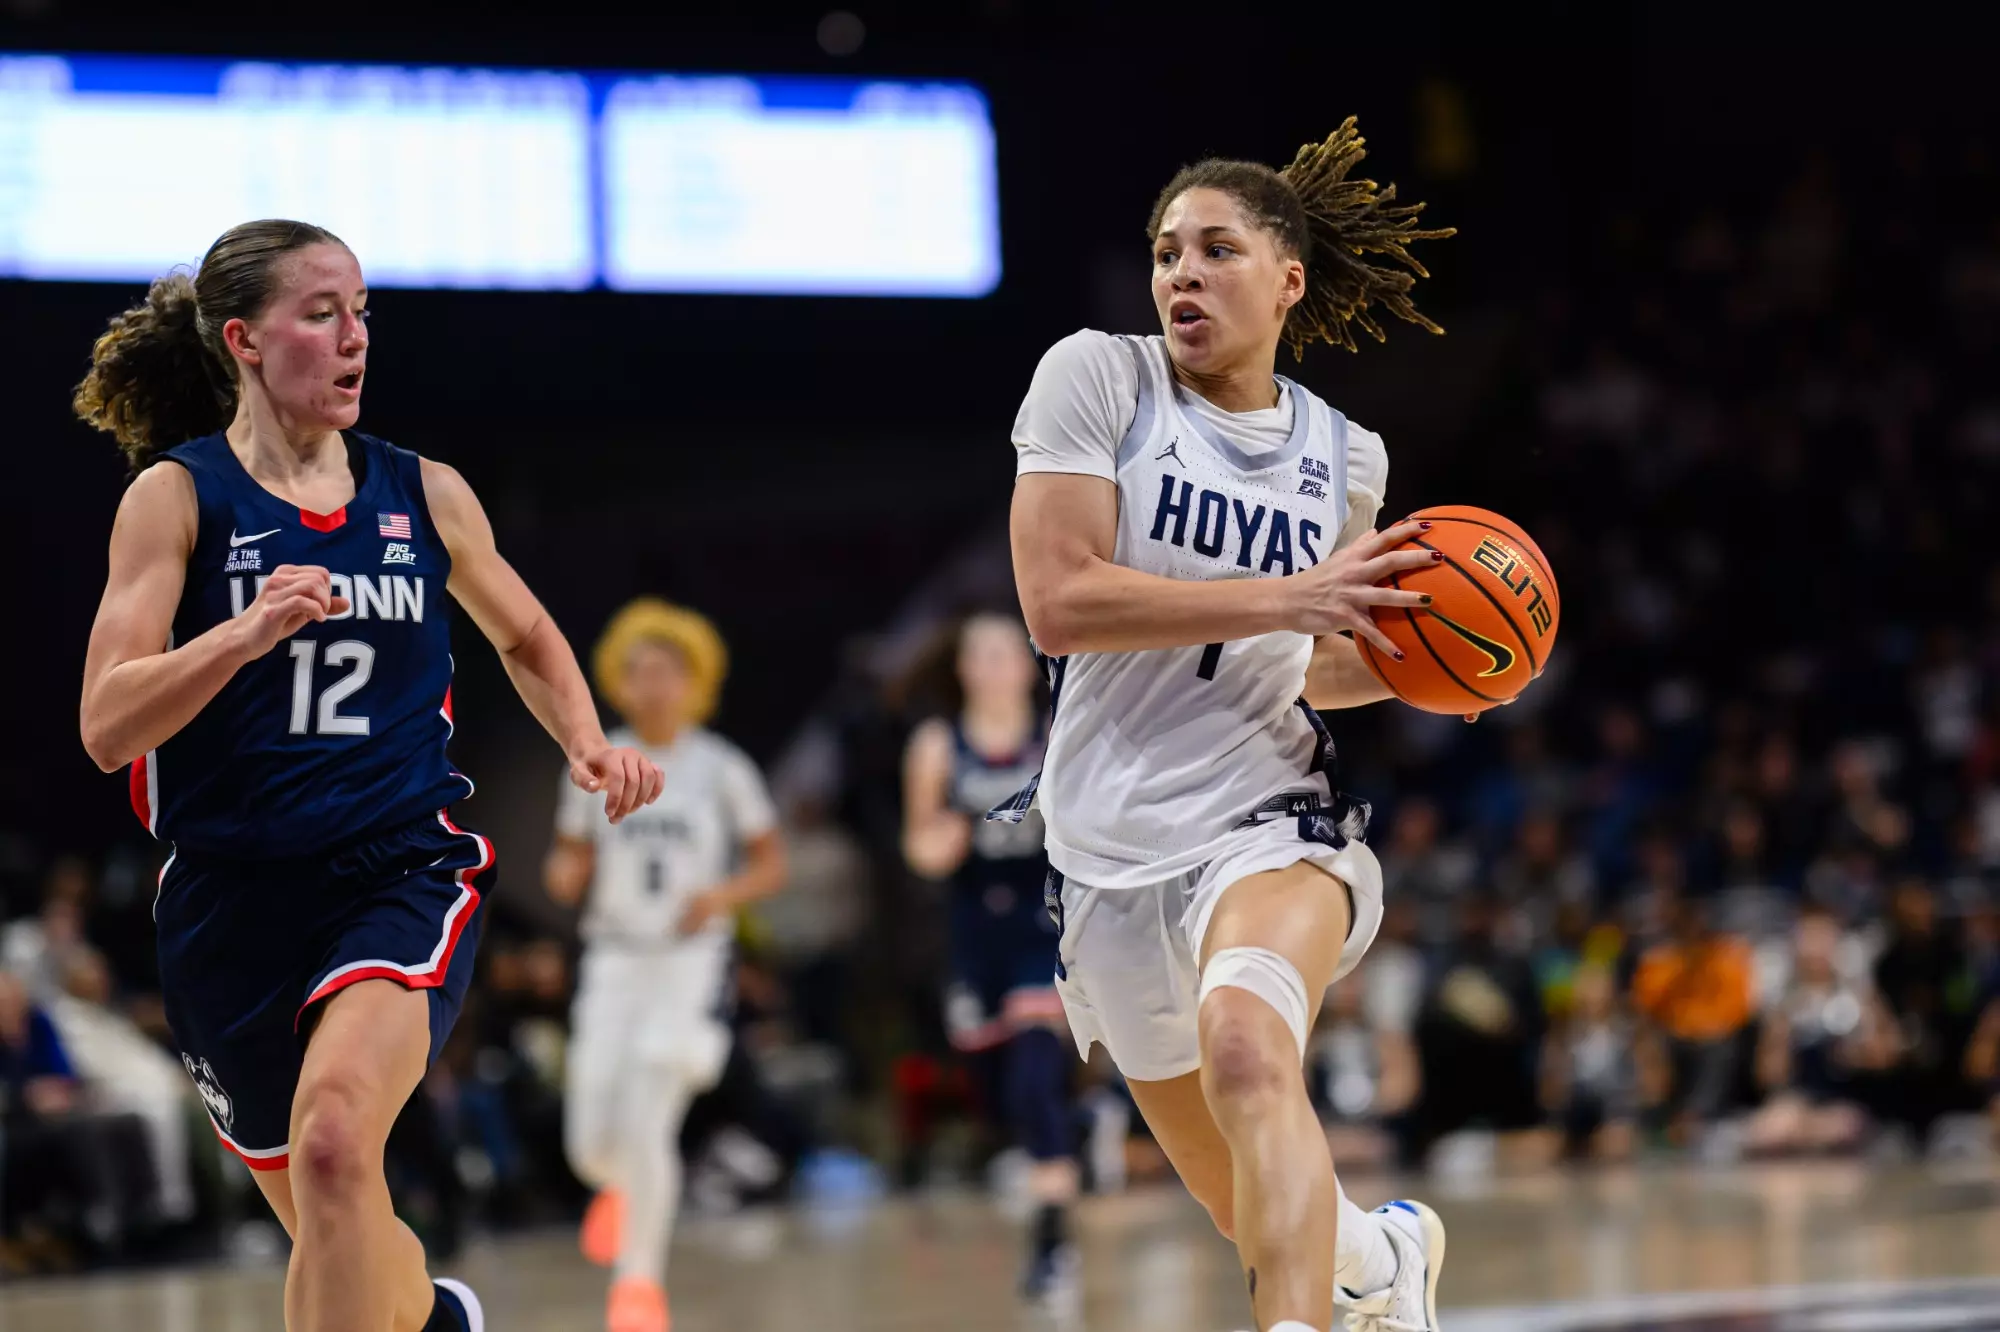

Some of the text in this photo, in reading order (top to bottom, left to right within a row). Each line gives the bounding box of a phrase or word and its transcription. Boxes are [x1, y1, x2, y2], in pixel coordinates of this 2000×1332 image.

[1302, 456, 1329, 474] BE THE
[1299, 465, 1330, 483] CHANGE
[1302, 478, 1322, 491] BIG
[1298, 485, 1328, 499] EAST
[1149, 473, 1322, 577] HOYAS
[240, 550, 260, 560] THE
[386, 543, 410, 554] BIG
[383, 551, 416, 562] EAST
[224, 559, 262, 572] CHANGE
[1470, 538, 1552, 638] ELITE
[229, 573, 424, 623] UONN
[289, 639, 376, 735] 12
[1292, 801, 1308, 813] 44
